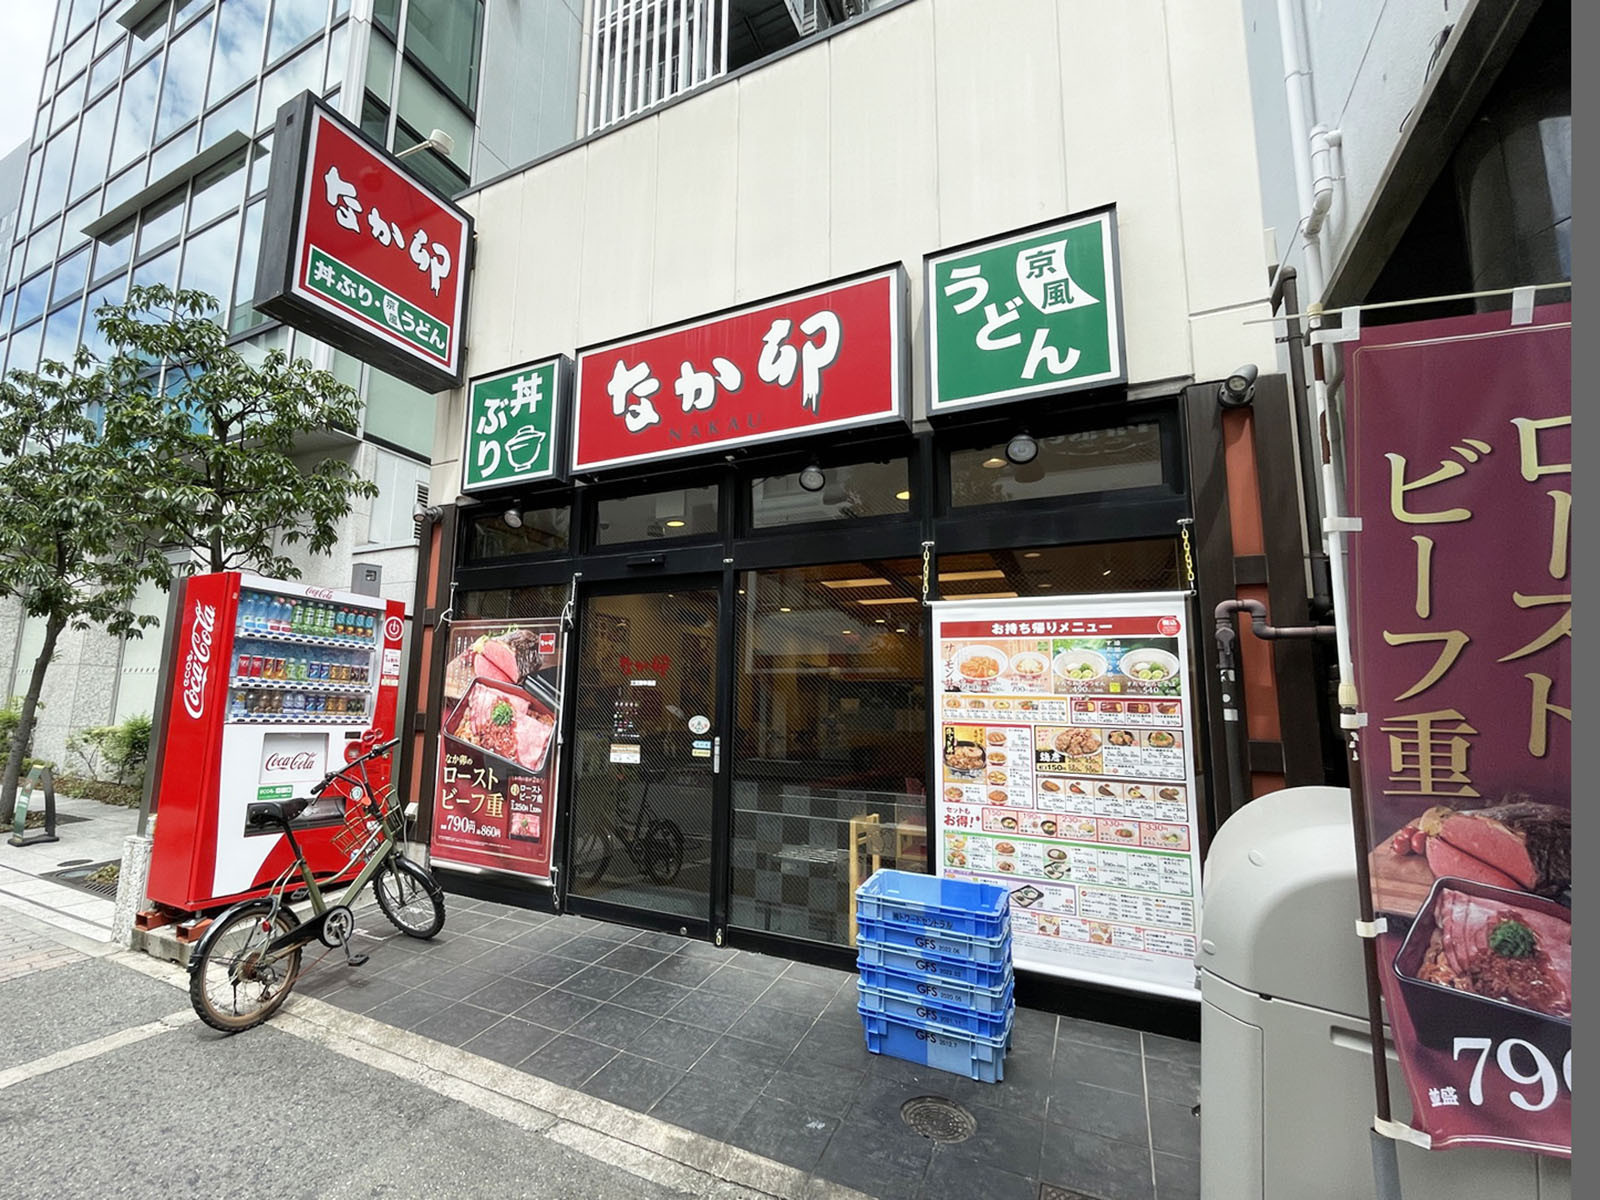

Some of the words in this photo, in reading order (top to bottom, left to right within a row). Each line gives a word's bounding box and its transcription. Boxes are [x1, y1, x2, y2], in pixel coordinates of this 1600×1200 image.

[324, 165, 451, 297] なか卯
[1025, 249, 1075, 309] 京風
[607, 309, 841, 433] なか卯
[668, 411, 765, 441] NAKAU
[991, 621, 1113, 635] お持ち帰りメニュー
[1380, 438, 1493, 797] ビーフ重
[443, 766, 498, 791] ロースト
[520, 785, 541, 793] ロースト
[441, 788, 504, 818] ビーフ重
[915, 937, 936, 950] GFS
[915, 959, 937, 973] GFS
[916, 984, 938, 997] GFS
[916, 1007, 937, 1021] GFS
[915, 1030, 937, 1043] GFS
[1428, 1085, 1460, 1107] 並盛
[1453, 1037, 1571, 1112] 79
